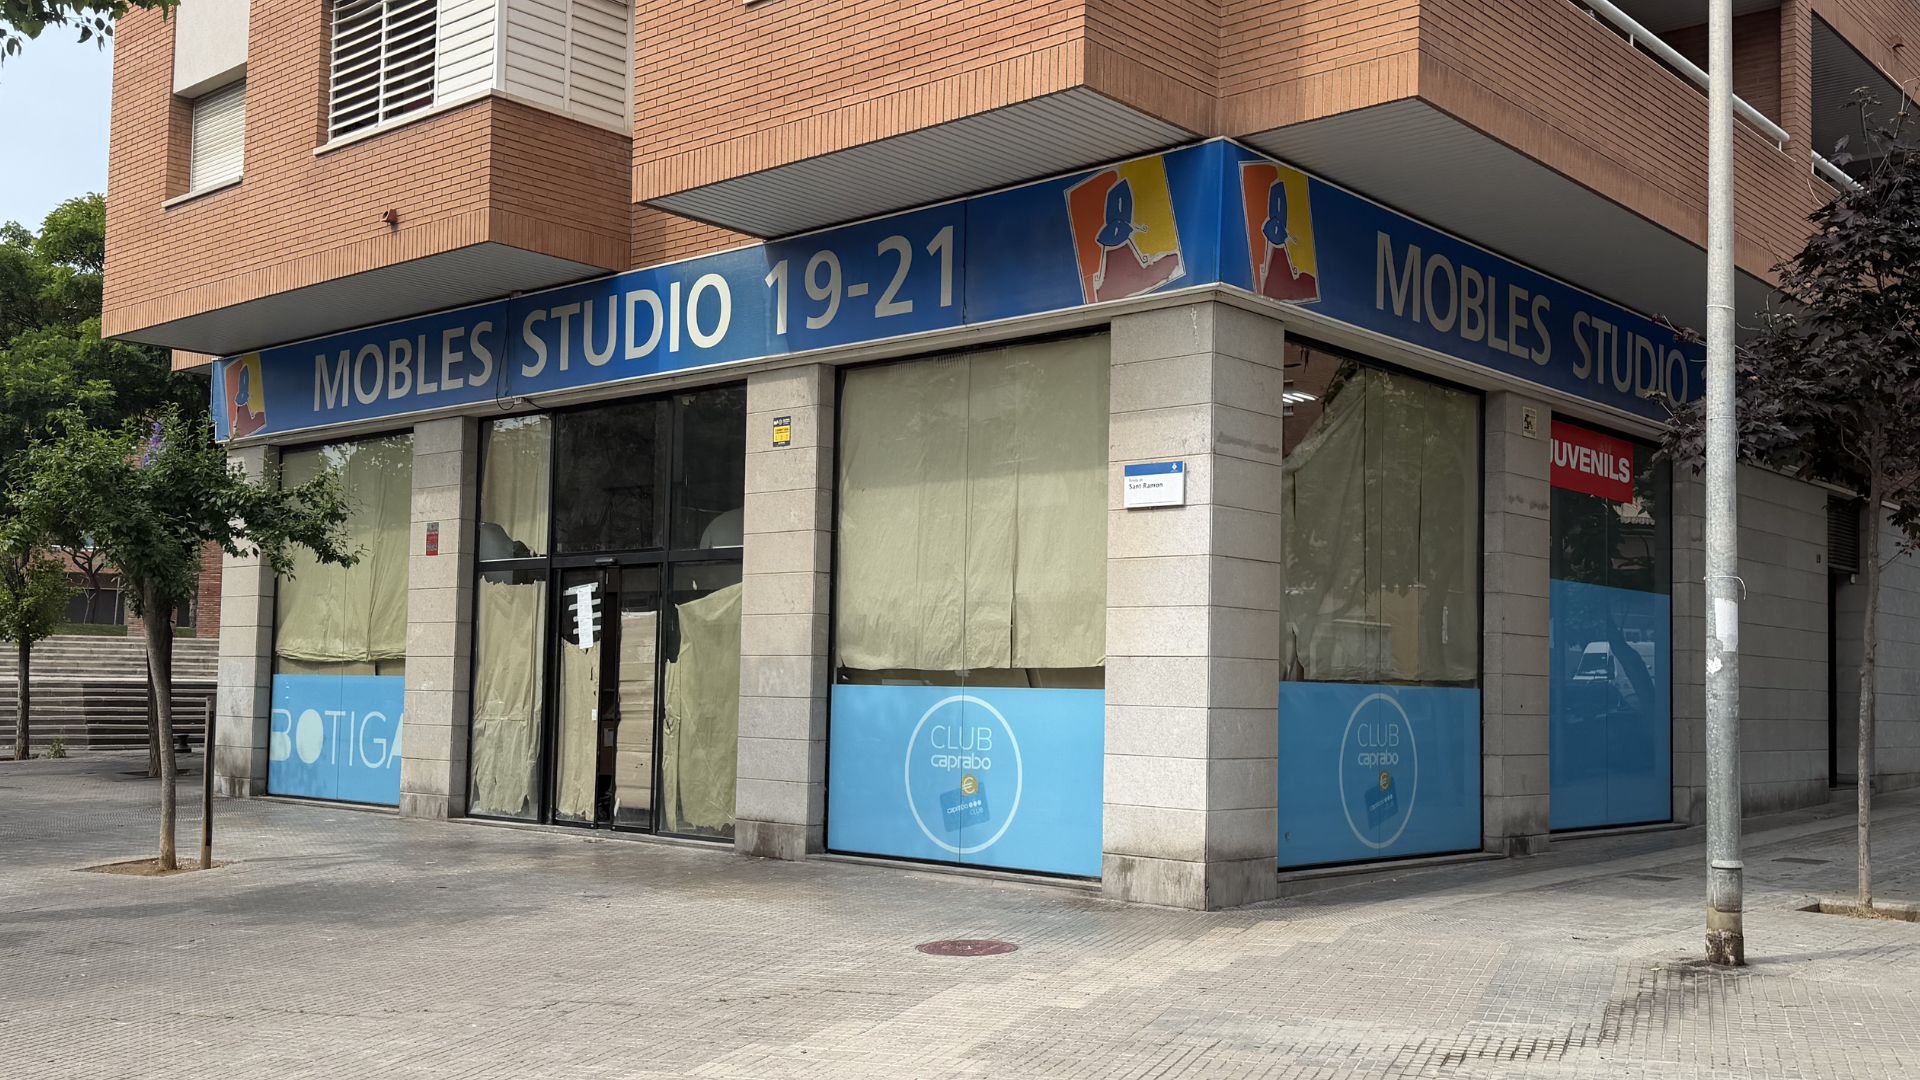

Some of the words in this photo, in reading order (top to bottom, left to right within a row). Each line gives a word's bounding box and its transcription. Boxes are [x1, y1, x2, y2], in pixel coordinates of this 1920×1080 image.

[313, 320, 494, 412] MOBLES
[521, 273, 732, 378] STUDIO
[764, 225, 954, 335] 19-21
[1376, 231, 1551, 366] MOBLES
[1573, 311, 1688, 409] STUDIO
[931, 725, 992, 751] CLUB
[1358, 723, 1400, 747] CLUB
[931, 753, 992, 772] caprabo
[1358, 750, 1399, 768] caprabo
